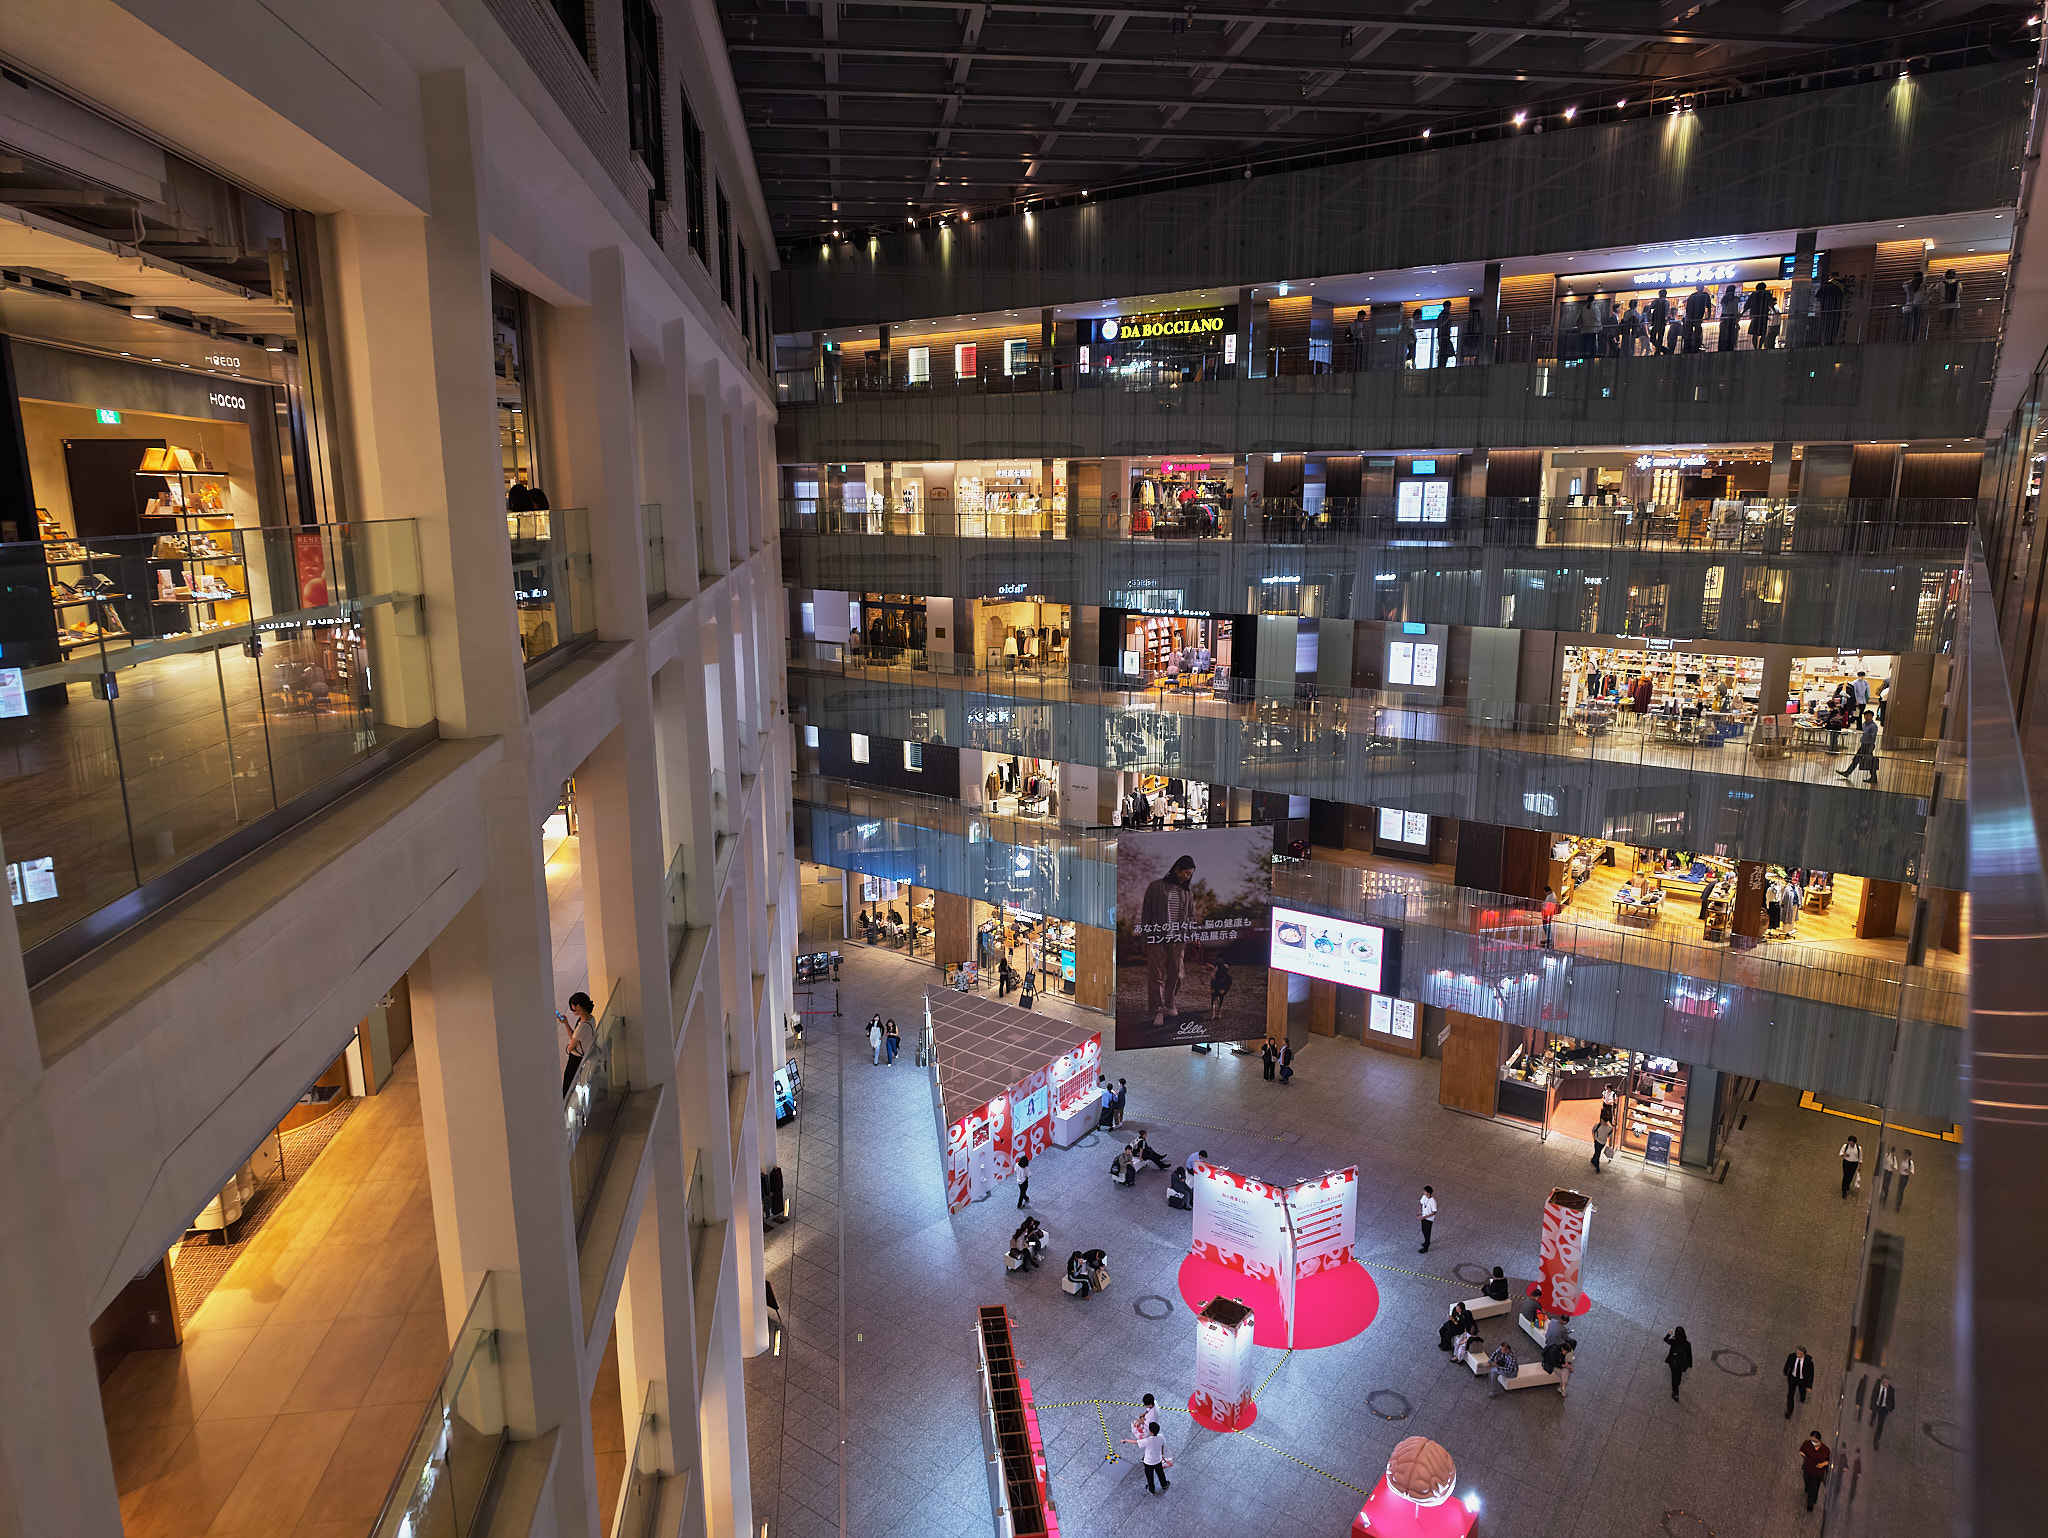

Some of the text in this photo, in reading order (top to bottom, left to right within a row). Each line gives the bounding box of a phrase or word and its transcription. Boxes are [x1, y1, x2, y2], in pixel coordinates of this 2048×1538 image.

[1120, 325, 1141, 339] DA
[1142, 317, 1224, 337] BOCCIANO
[1133, 917, 1252, 934] あなたの日々に、脳の健康も
[1146, 929, 1238, 945] コンテスト作品展示会
[1177, 1021, 1207, 1035] Lilly
